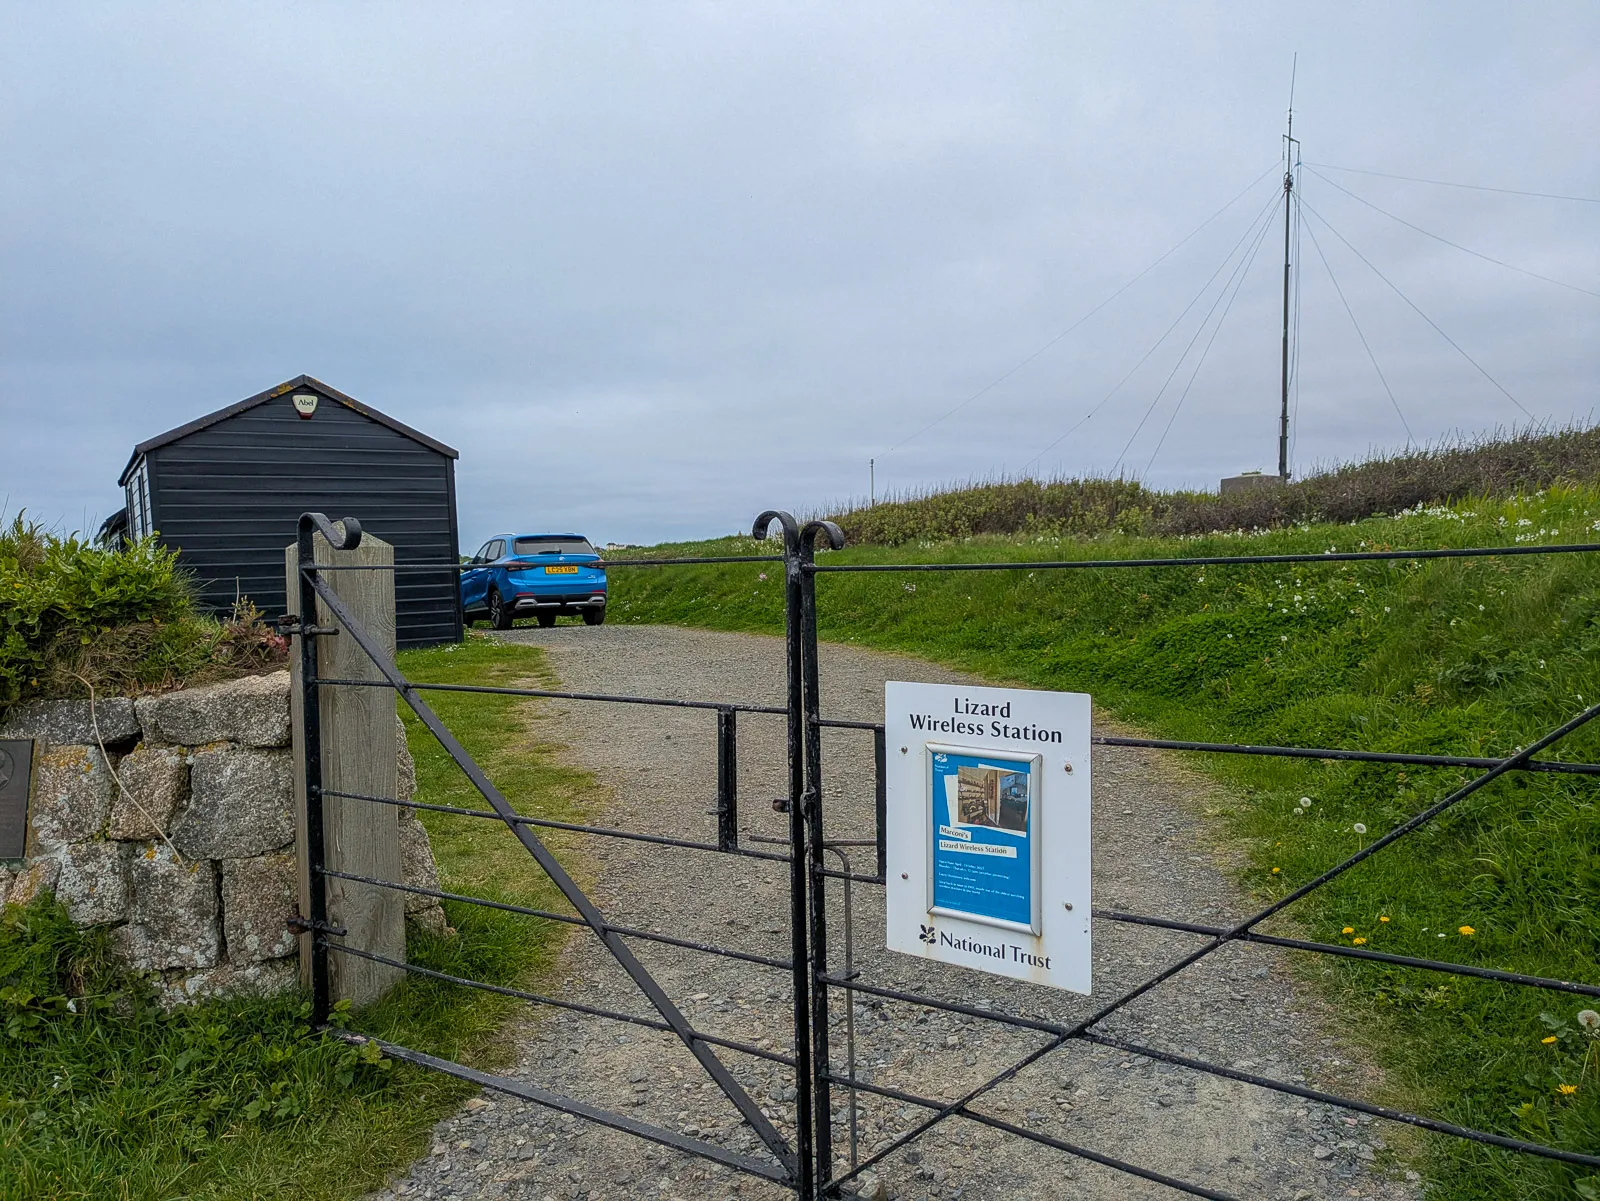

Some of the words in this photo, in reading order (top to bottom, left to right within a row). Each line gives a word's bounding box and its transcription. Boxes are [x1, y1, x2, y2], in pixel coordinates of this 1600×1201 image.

[954, 697, 1011, 719] Lizard
[909, 713, 985, 736] Wireless
[990, 720, 1063, 744] Station
[940, 826, 969, 839] Marconi's
[940, 841, 959, 849] Lizard
[959, 843, 984, 852] Wireless
[985, 846, 1008, 855] Station
[940, 930, 1006, 960] National
[1009, 945, 1052, 970] Trust
